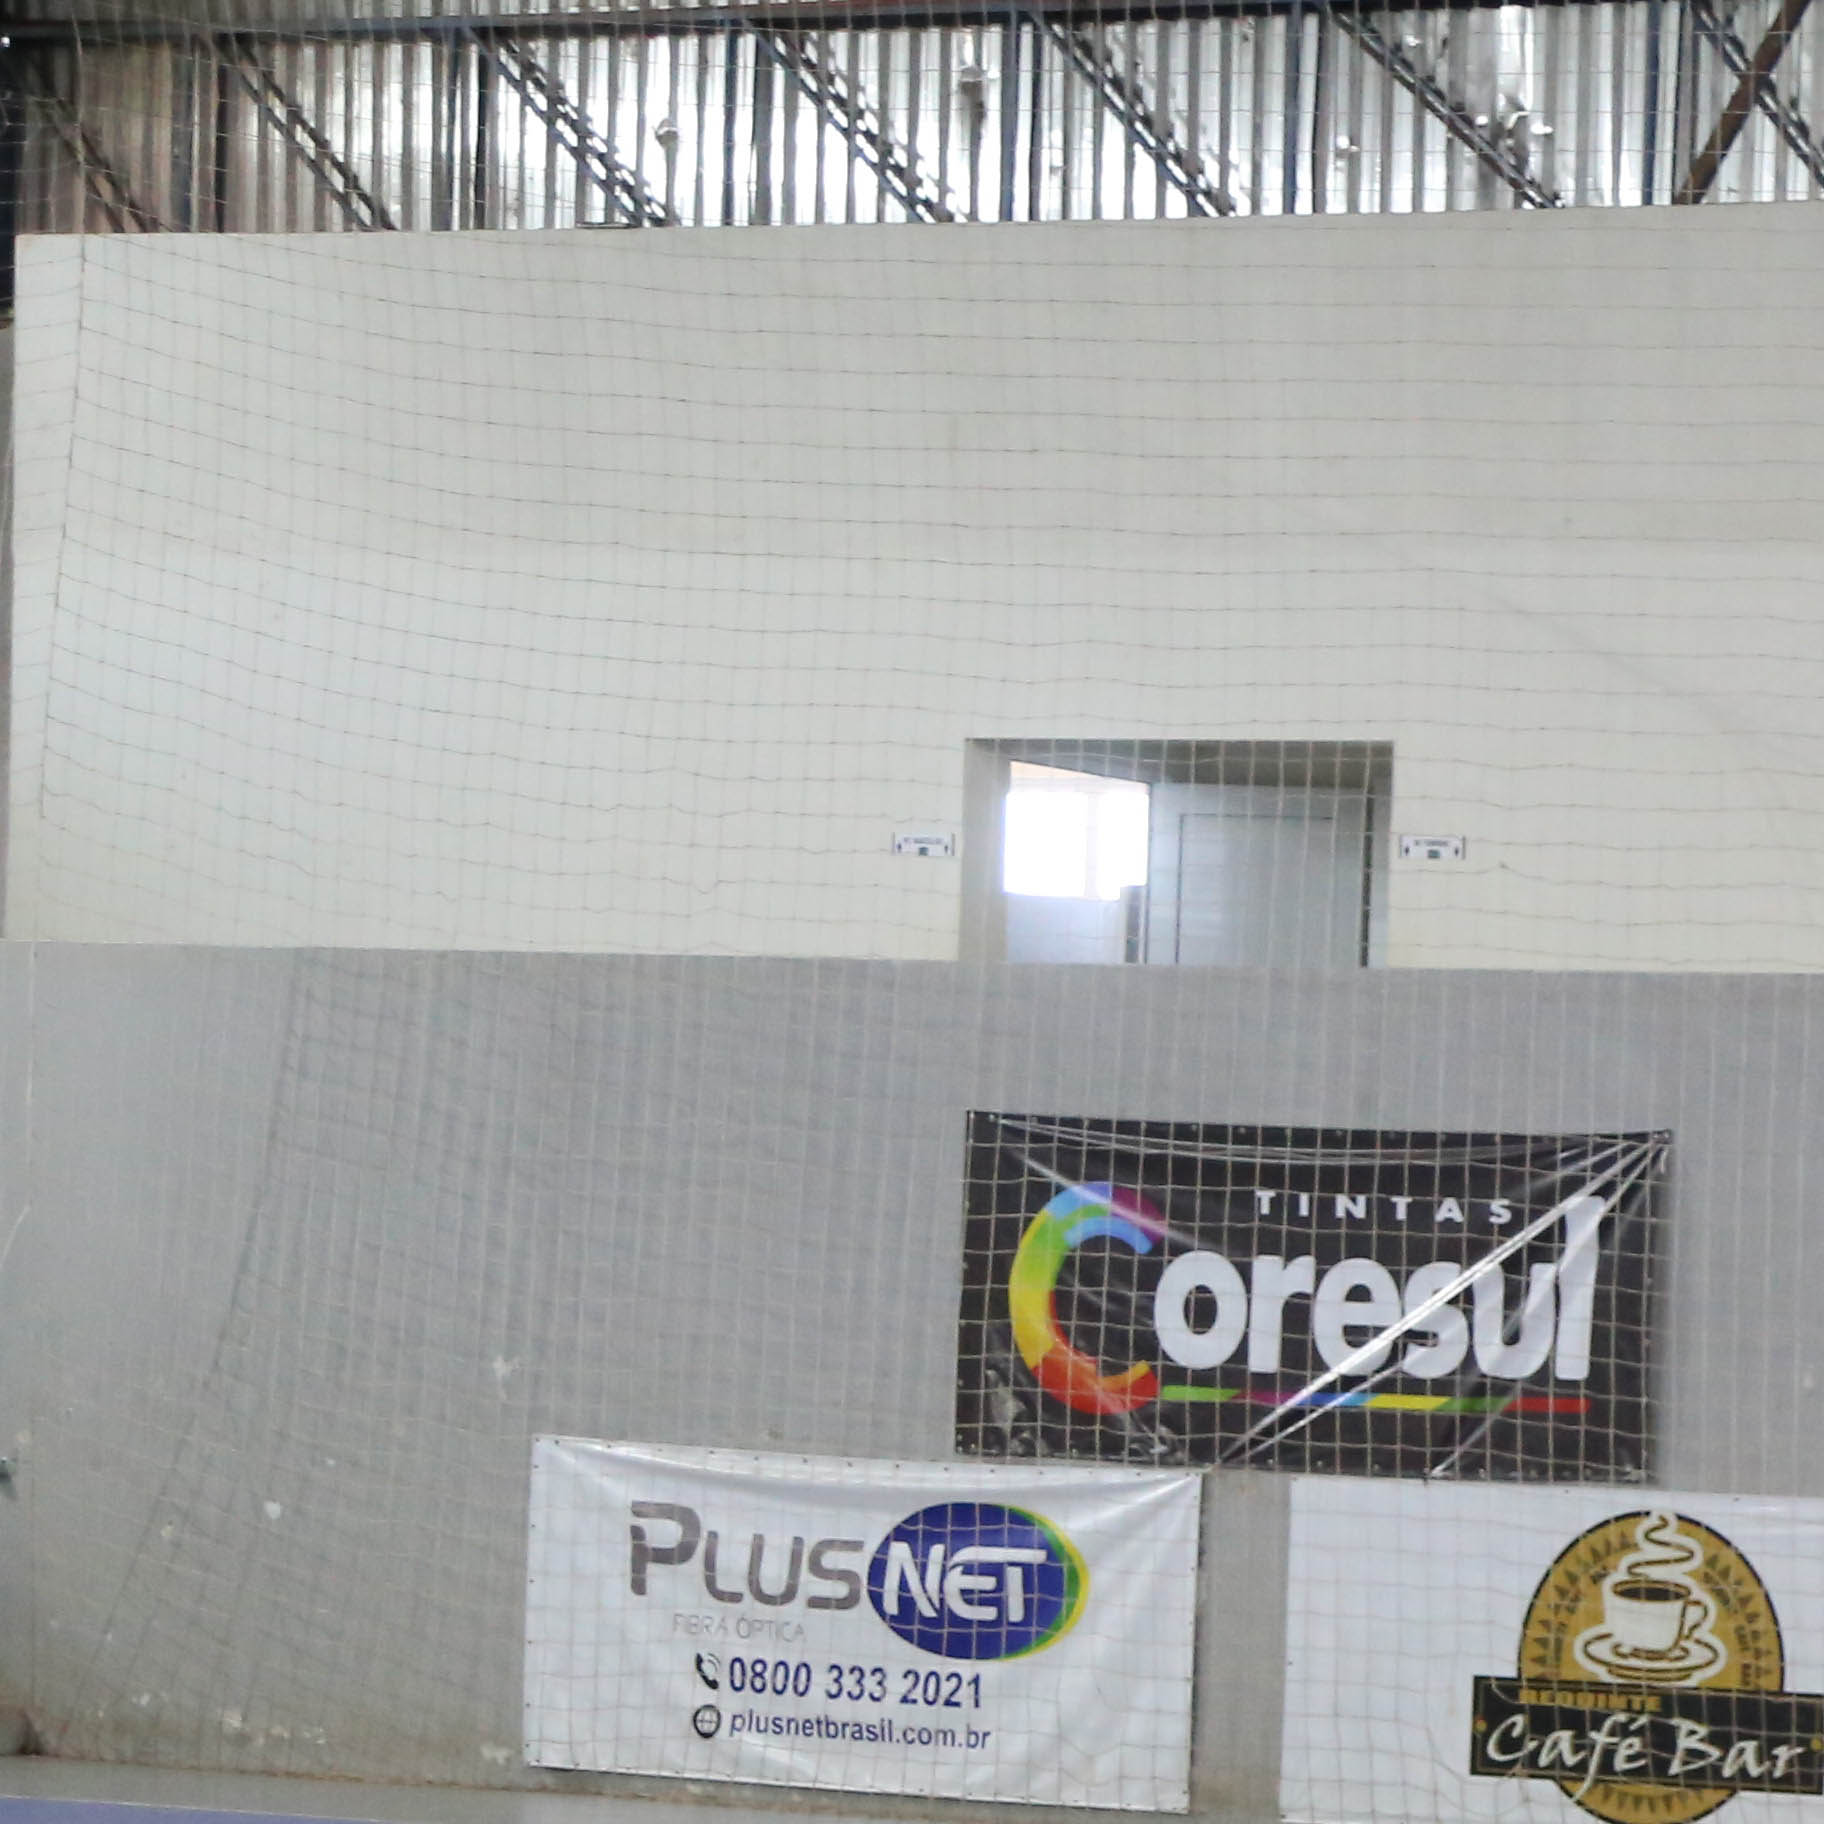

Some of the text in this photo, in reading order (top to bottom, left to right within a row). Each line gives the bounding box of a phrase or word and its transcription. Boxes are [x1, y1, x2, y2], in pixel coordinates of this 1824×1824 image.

[1258, 1190, 1512, 1224] TINTAS
[729, 1656, 984, 1709] 0800 333 2021
[729, 1713, 991, 1752] plusnetbrasil.com.br
[1485, 1710, 1807, 1801] Café Bar
